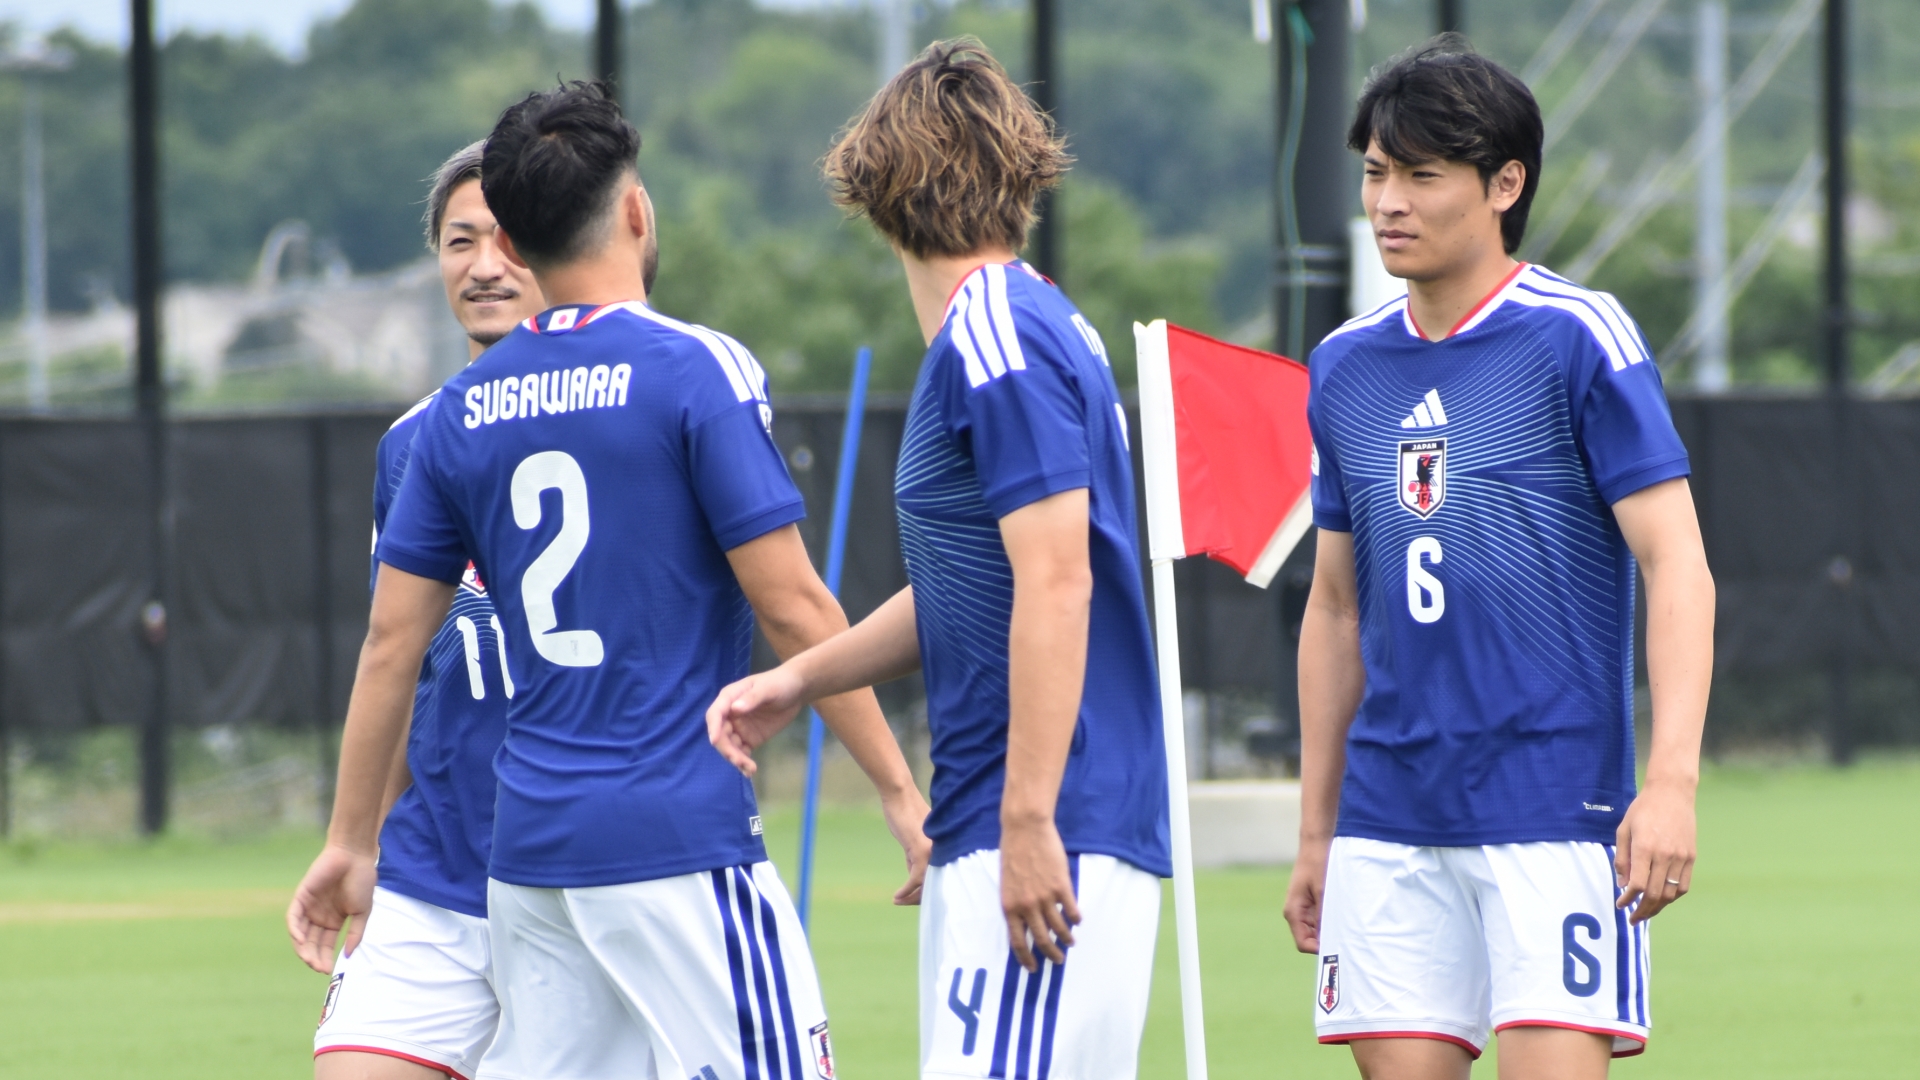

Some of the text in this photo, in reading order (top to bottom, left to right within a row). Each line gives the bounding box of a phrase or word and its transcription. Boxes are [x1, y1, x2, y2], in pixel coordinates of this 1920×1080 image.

[463, 362, 632, 430] SUGAWARA
[1411, 442, 1437, 451] JAPAN
[1413, 492, 1434, 505] JFA
[509, 449, 605, 668] 2
[1407, 536, 1446, 624] 6
[456, 614, 515, 700] 11
[1562, 911, 1602, 998] 6
[947, 966, 988, 1057] 4
